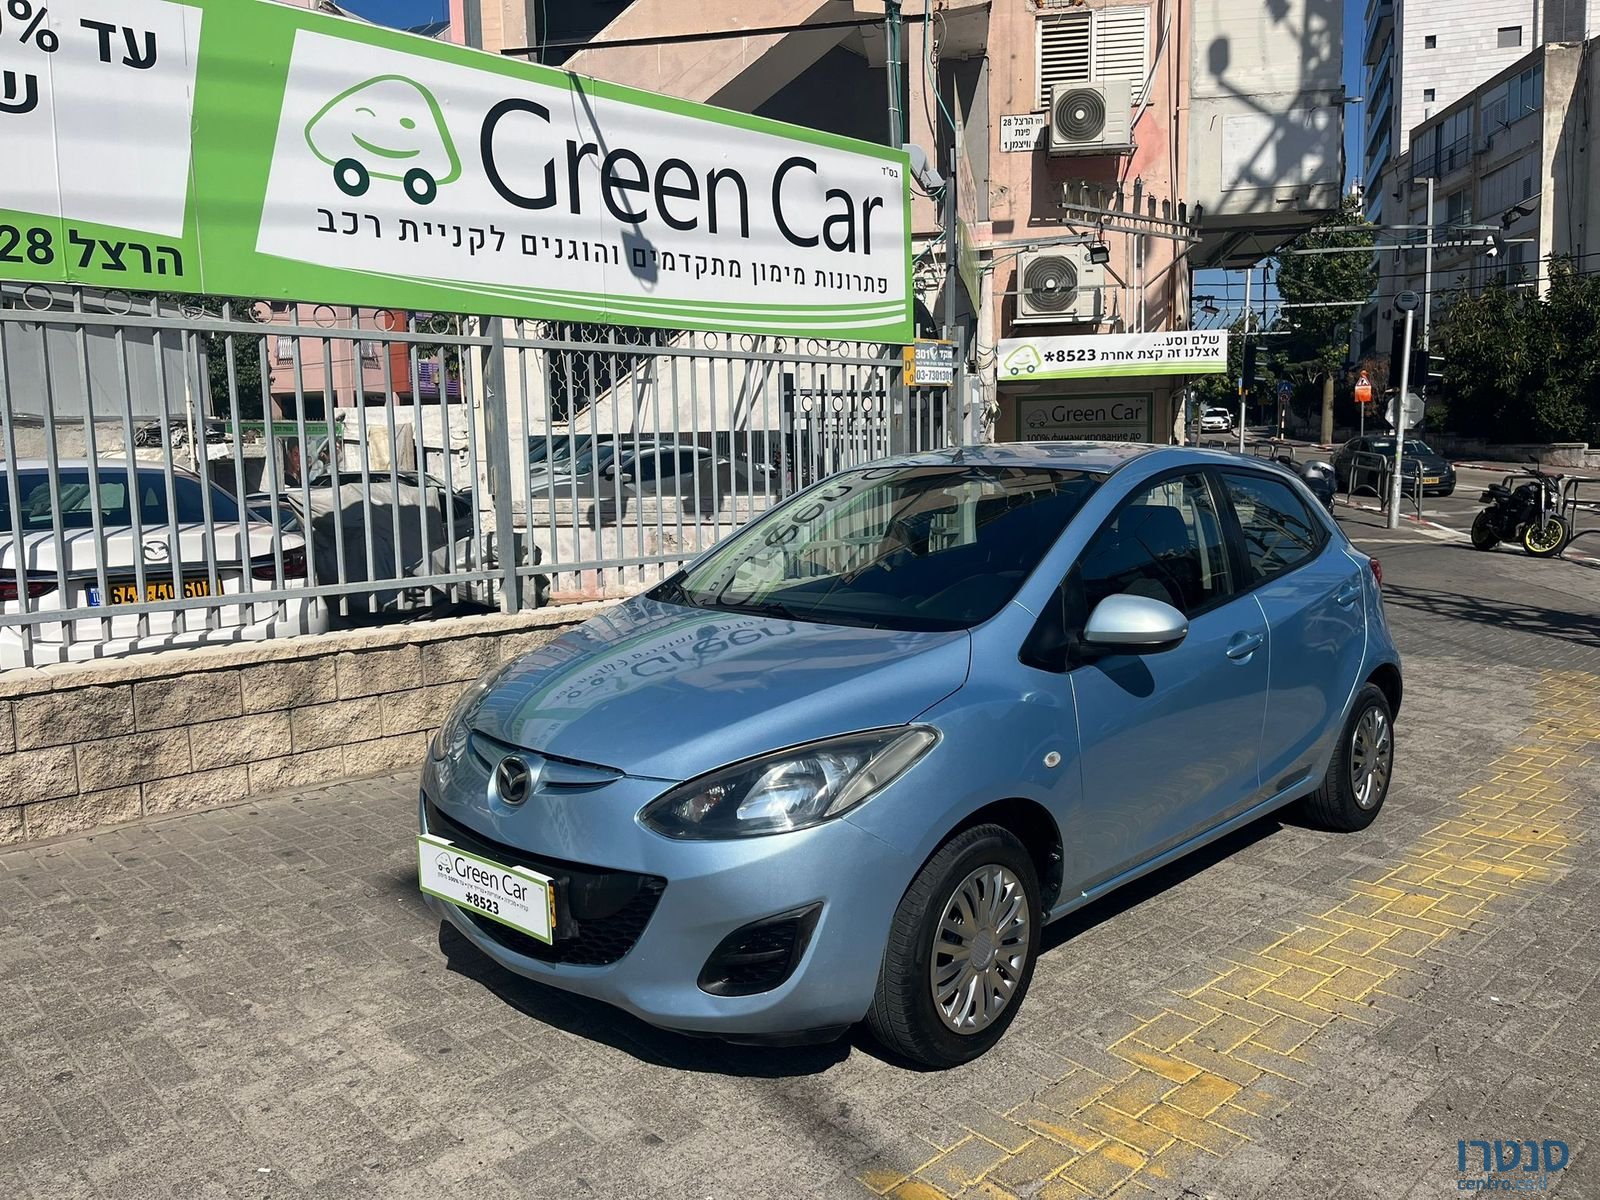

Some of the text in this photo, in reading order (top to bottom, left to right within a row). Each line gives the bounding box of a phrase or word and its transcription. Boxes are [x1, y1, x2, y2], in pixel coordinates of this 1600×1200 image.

[80, 19, 157, 70] עד
[1003, 118, 1012, 126] 28
[1014, 116, 1033, 126] הרצל
[1014, 128, 1030, 136] פינת
[1004, 141, 1008, 149] 1
[480, 98, 883, 255] Green Car
[881, 166, 898, 178] בס"ד
[0, 225, 183, 276] הרצל 28
[317, 208, 887, 294] פתרונות מימון מתקדמים והוגנים לקניית רכב
[1192, 334, 1219, 345] שלם
[915, 349, 930, 359] 301
[1100, 350, 1133, 360] אחרת
[1137, 349, 1163, 361] קצת
[1167, 348, 1181, 358] זה
[1185, 346, 1219, 357] אצלנו
[1051, 403, 1142, 422] Green Car
[454, 857, 527, 901] Green Car
